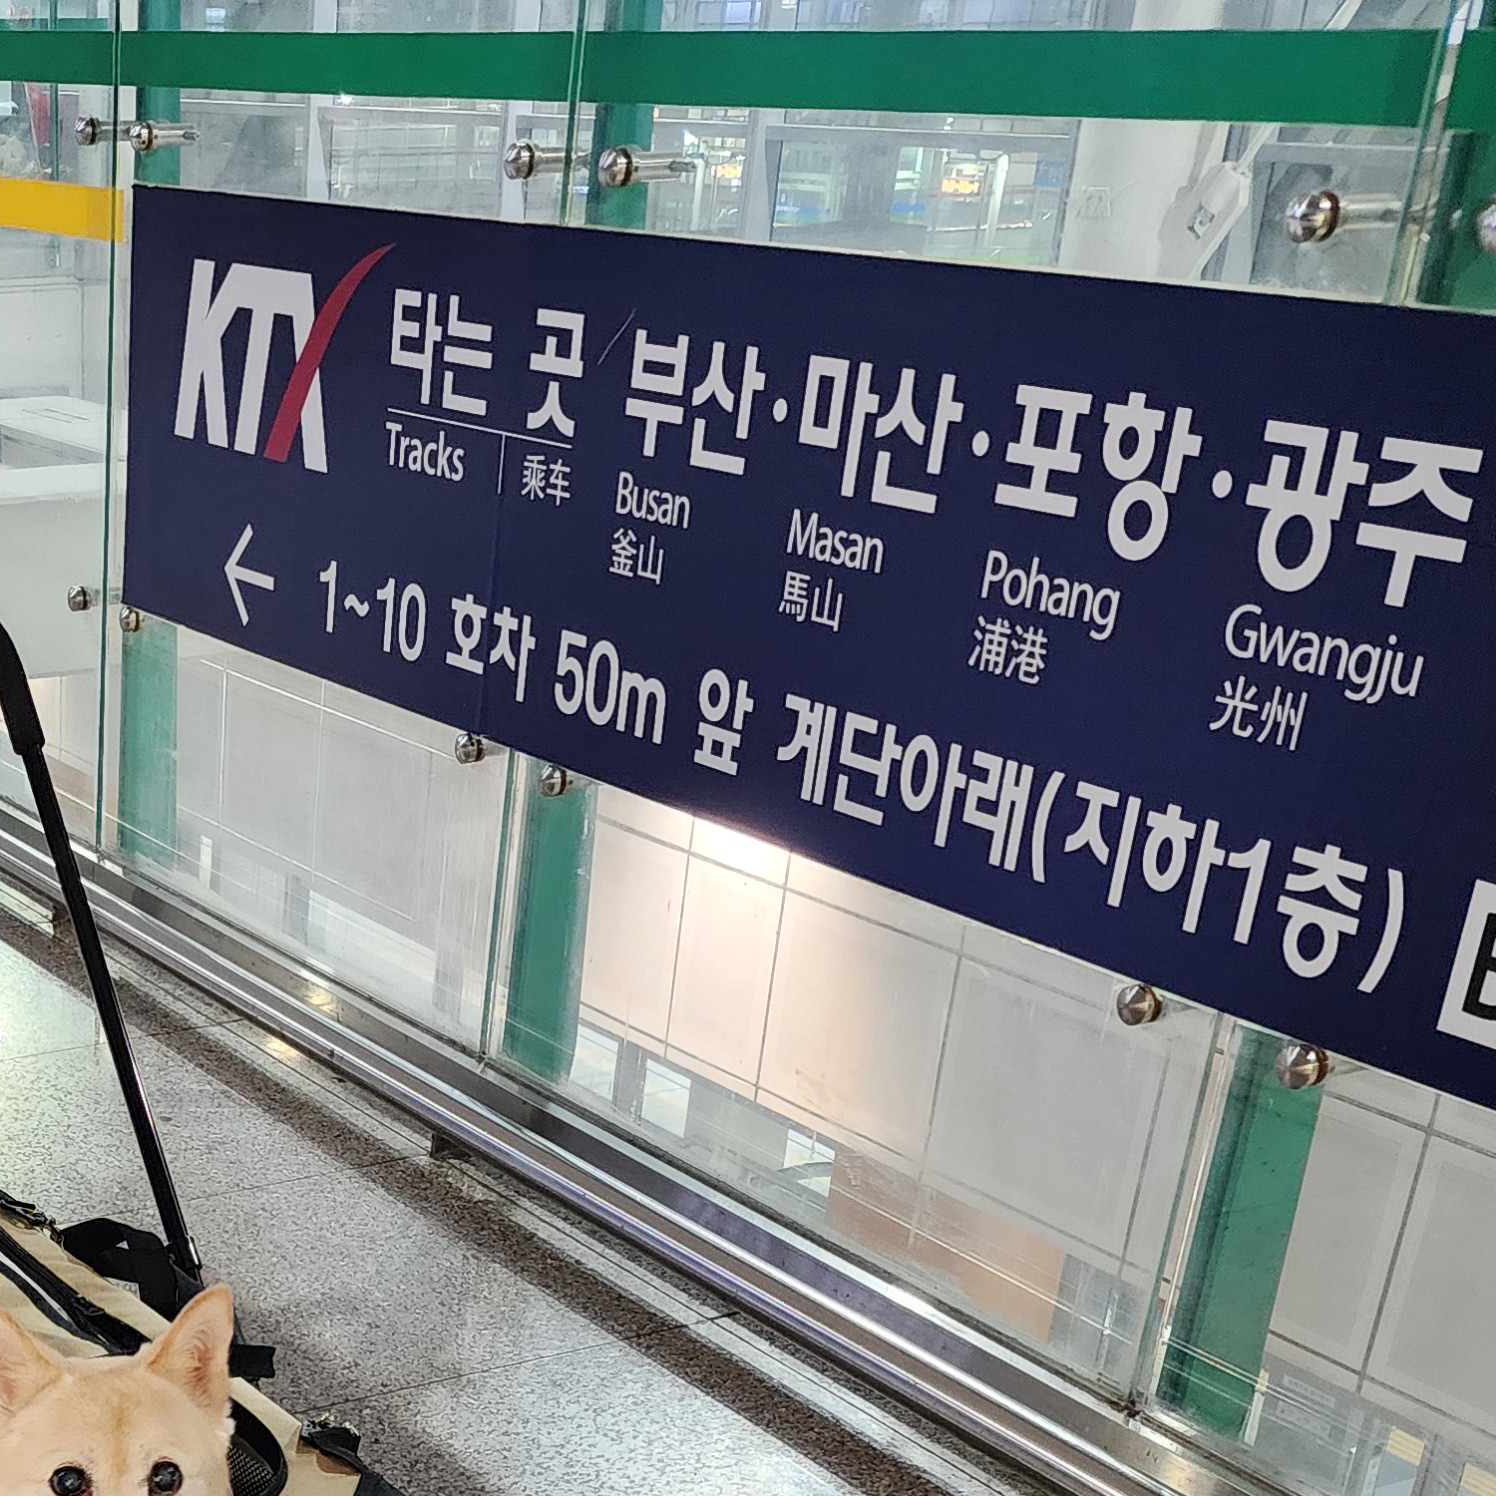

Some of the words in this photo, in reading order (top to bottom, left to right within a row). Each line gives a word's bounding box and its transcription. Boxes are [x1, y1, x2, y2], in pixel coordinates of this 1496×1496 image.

[174, 243, 396, 474] KTX
[390, 288, 493, 417] 타는
[526, 308, 585, 438] 곳
[385, 421, 465, 482] Tracks
[521, 454, 572, 506] 乘车
[615, 471, 690, 529] Busan
[608, 527, 664, 585] 釜山
[786, 508, 884, 574] Masan
[778, 570, 844, 632] 馬山
[981, 550, 1121, 641] Pohang
[967, 615, 1048, 684] 浦港
[1225, 603, 1424, 704] Gwangju
[1209, 675, 1308, 751] 光州
[319, 560, 427, 662] 1~10
[445, 593, 537, 703] 호차
[554, 629, 666, 745] 50m
[693, 668, 755, 776] 앞
[776, 693, 1405, 994] 계단아래(지하1층)
